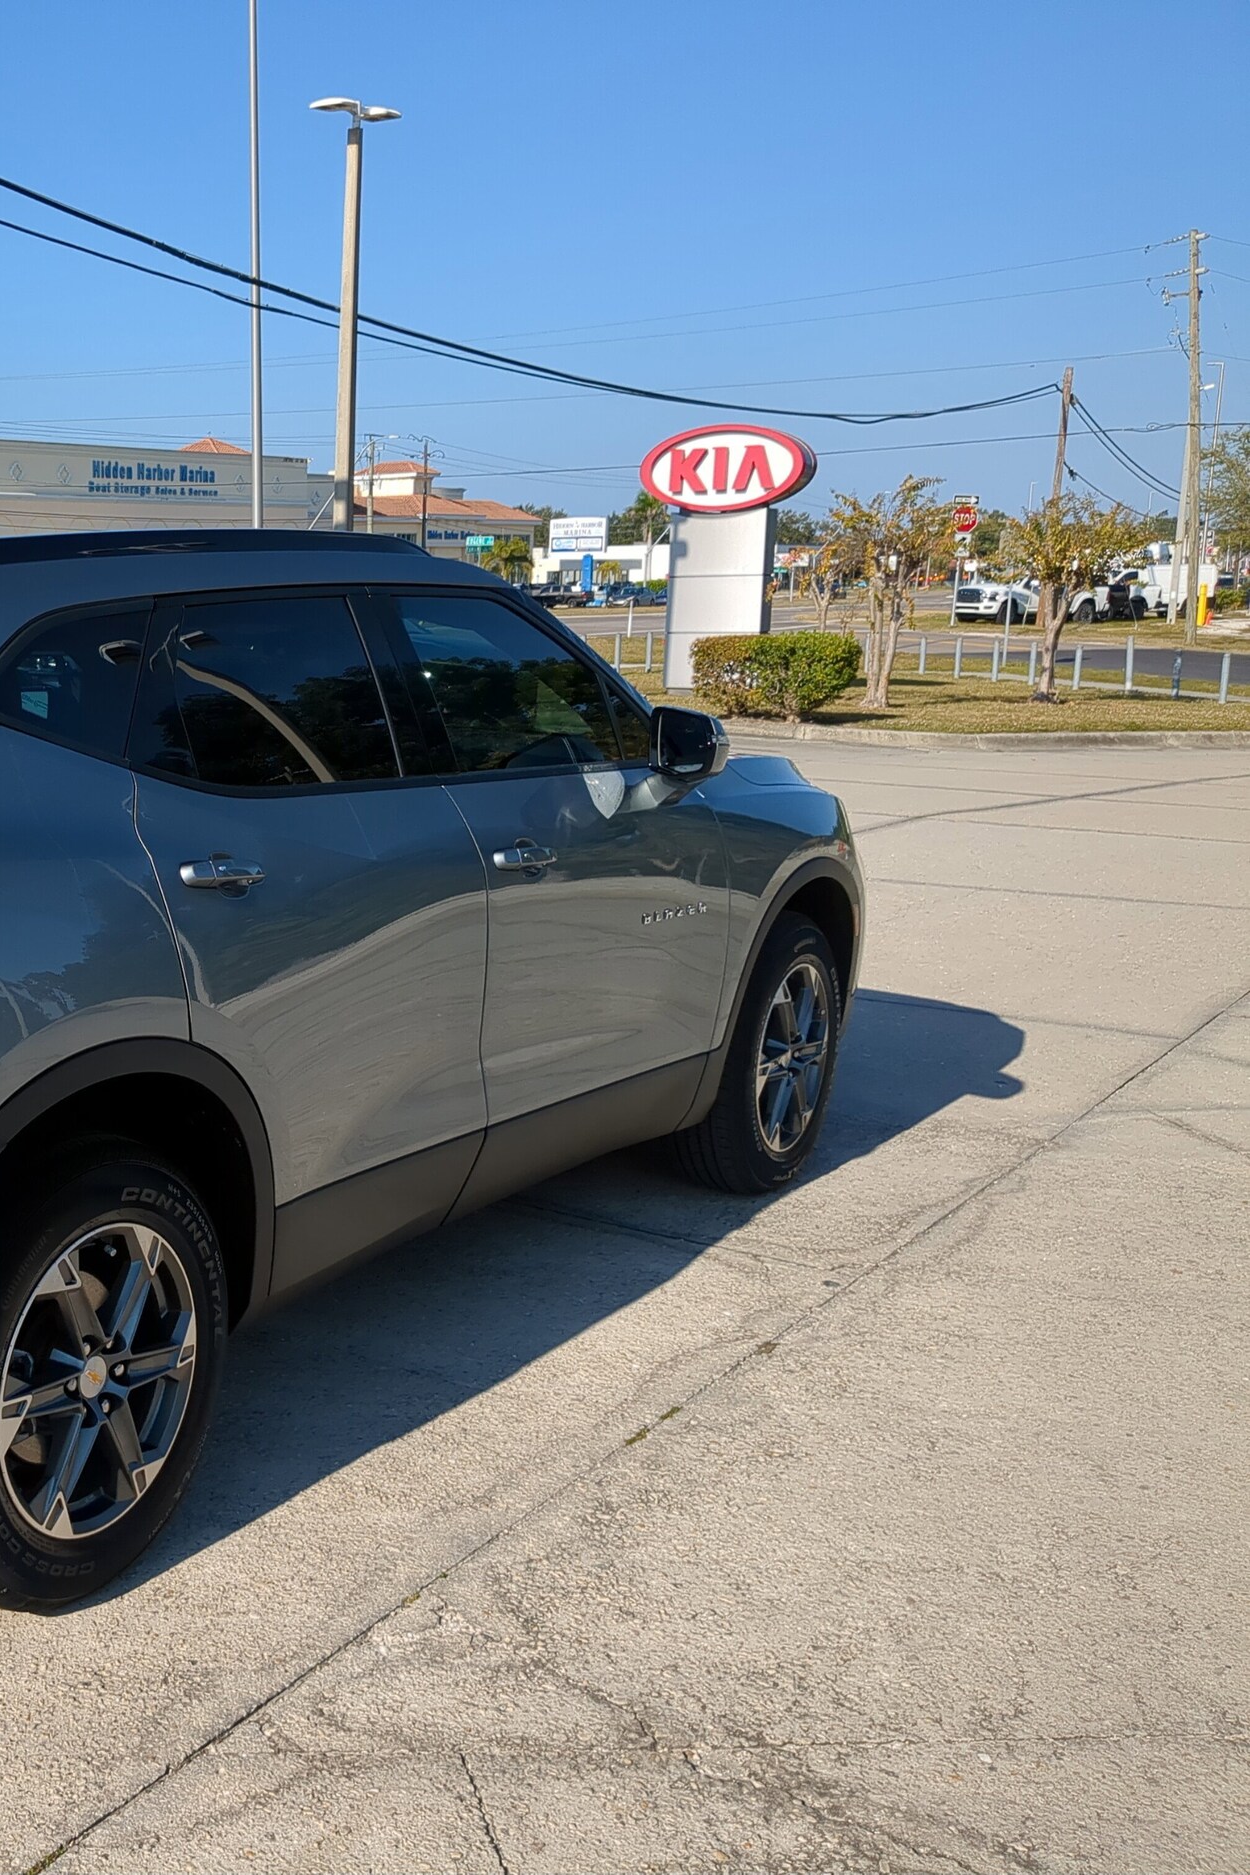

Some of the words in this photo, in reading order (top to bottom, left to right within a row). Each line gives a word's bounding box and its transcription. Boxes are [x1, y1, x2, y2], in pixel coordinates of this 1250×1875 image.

[92, 460, 133, 479] Hidden
[137, 462, 175, 481] Harbor
[179, 464, 216, 483] Marina
[668, 445, 776, 494] KIA
[88, 480, 111, 493] Boat
[114, 482, 151, 496] Storage
[155, 486, 177, 495] Sales
[180, 487, 185, 495] &
[188, 487, 218, 496] Service
[953, 513, 976, 525] STOP
[642, 901, 708, 925] BLAZER
[121, 1186, 227, 1350] CONTINENTAL
